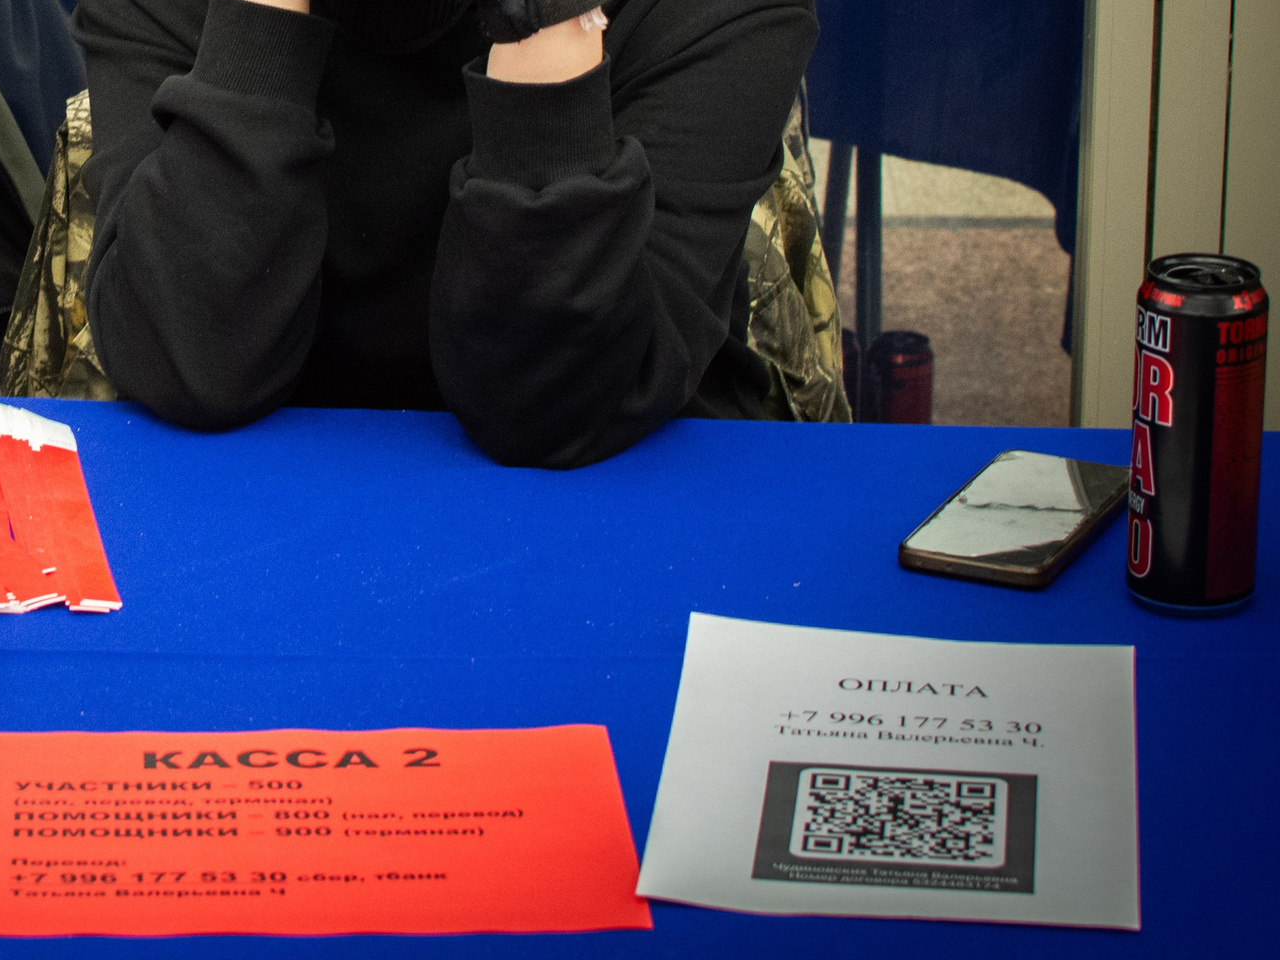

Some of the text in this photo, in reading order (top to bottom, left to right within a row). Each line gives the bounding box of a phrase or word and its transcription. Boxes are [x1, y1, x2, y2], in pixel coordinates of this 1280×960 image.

[838, 678, 988, 698] ОПЛАТА
[780, 710, 1042, 735] +7 996 177 53 30
[774, 725, 1045, 748] Татьяна Валерьевна Ч.
[143, 748, 441, 769] КАССА 2
[16, 781, 211, 791] УЧАСТНИКИ
[249, 781, 302, 790] 500
[14, 811, 237, 822] ПОМОЩНИКИ
[275, 810, 329, 820] 800
[413, 808, 523, 819] перевод)
[14, 828, 237, 839] ПОМОЩНИКИ
[276, 827, 331, 836] 900
[344, 827, 484, 837] (терминал)
[11, 873, 46, 883] +7
[60, 873, 117, 883] 996
[132, 872, 187, 883] 177
[201, 872, 237, 882] 53
[250, 872, 287, 882] 30
[13, 889, 106, 897] Татьяна
[115, 889, 260, 898] Валерьевна
